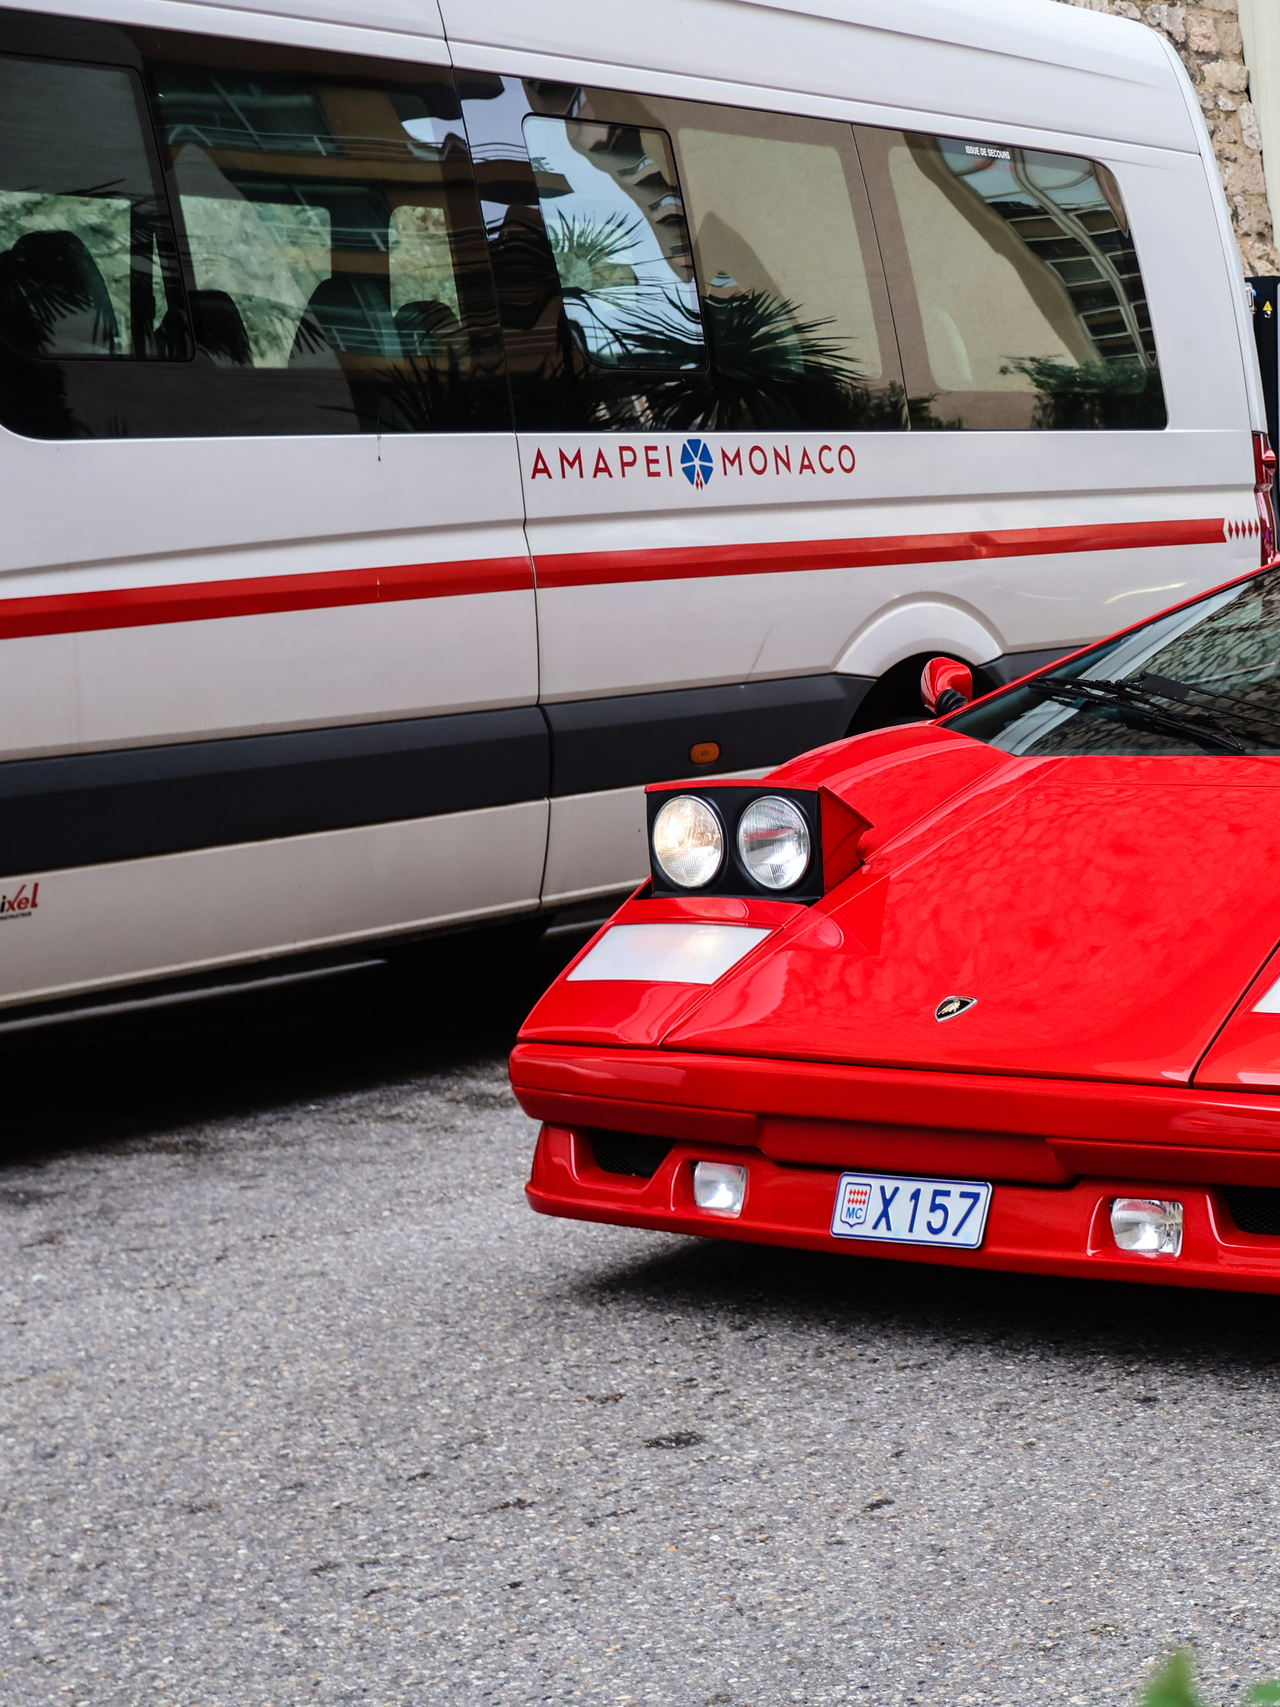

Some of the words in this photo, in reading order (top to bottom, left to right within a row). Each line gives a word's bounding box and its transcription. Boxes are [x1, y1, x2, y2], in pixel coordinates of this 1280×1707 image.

[965, 145, 980, 155] ISSUE
[980, 147, 988, 156] DE
[987, 149, 1010, 159] SECOURS
[531, 445, 673, 479] AMAPEI
[720, 445, 856, 476] MONACO
[845, 1207, 864, 1220] MC
[871, 1185, 981, 1237] X157
